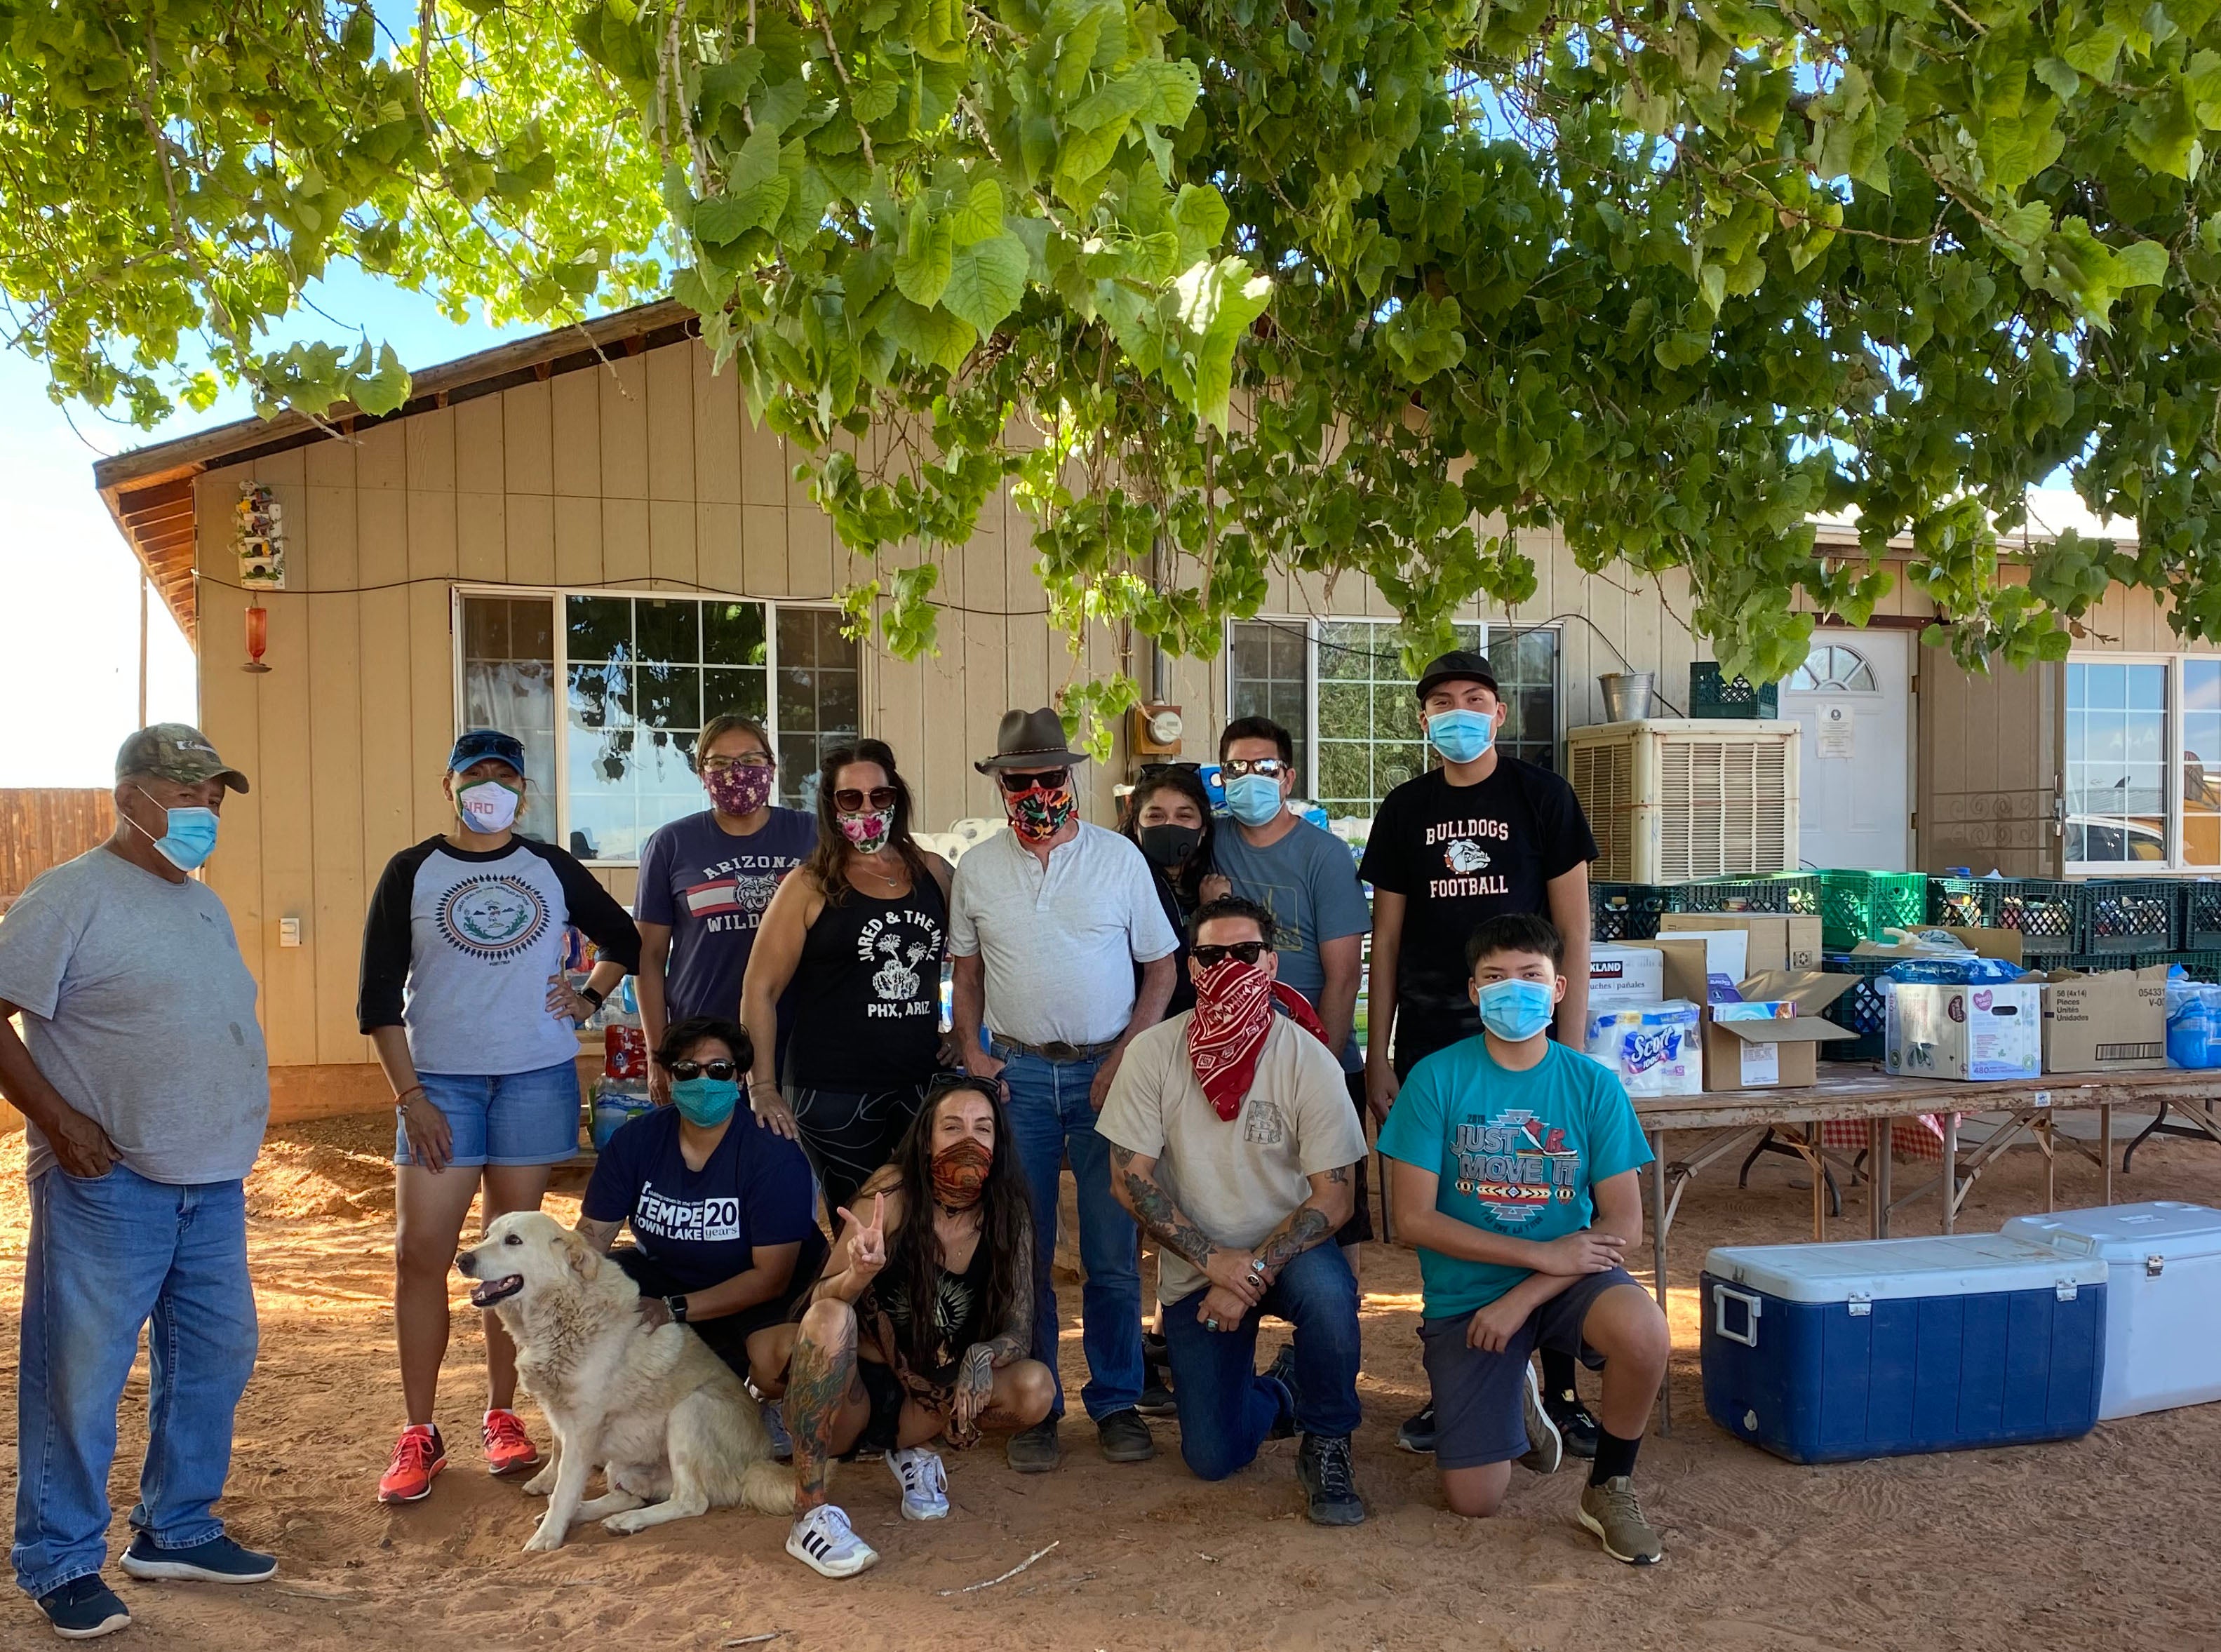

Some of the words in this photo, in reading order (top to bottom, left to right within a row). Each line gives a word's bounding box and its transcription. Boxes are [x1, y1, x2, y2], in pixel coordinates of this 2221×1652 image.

[1425, 819, 1509, 845] BULLDOGS
[703, 856, 802, 880] ARIZONA
[1430, 875, 1509, 898] FOOTBALL
[707, 913, 763, 933] WILD
[857, 918, 883, 962] JARED
[885, 911, 901, 924] &
[904, 910, 935, 932] THE
[925, 929, 941, 961] MILL
[1590, 962, 1621, 972] KLAND
[2067, 989, 2087, 998] (4x14)
[868, 1003, 903, 1019] PHX,
[905, 1000, 931, 1016] ARIZ
[1631, 1026, 1675, 1063] Scott
[1643, 1053, 1660, 1070] 1000
[1449, 1123, 1522, 1155] JUST
[1458, 1153, 1543, 1185] MOVE
[1552, 1158, 1582, 1186] IT
[637, 1195, 704, 1228] TEMPE
[705, 1201, 737, 1228] 20
[668, 1228, 702, 1241] LAKE
[705, 1228, 737, 1239] years
